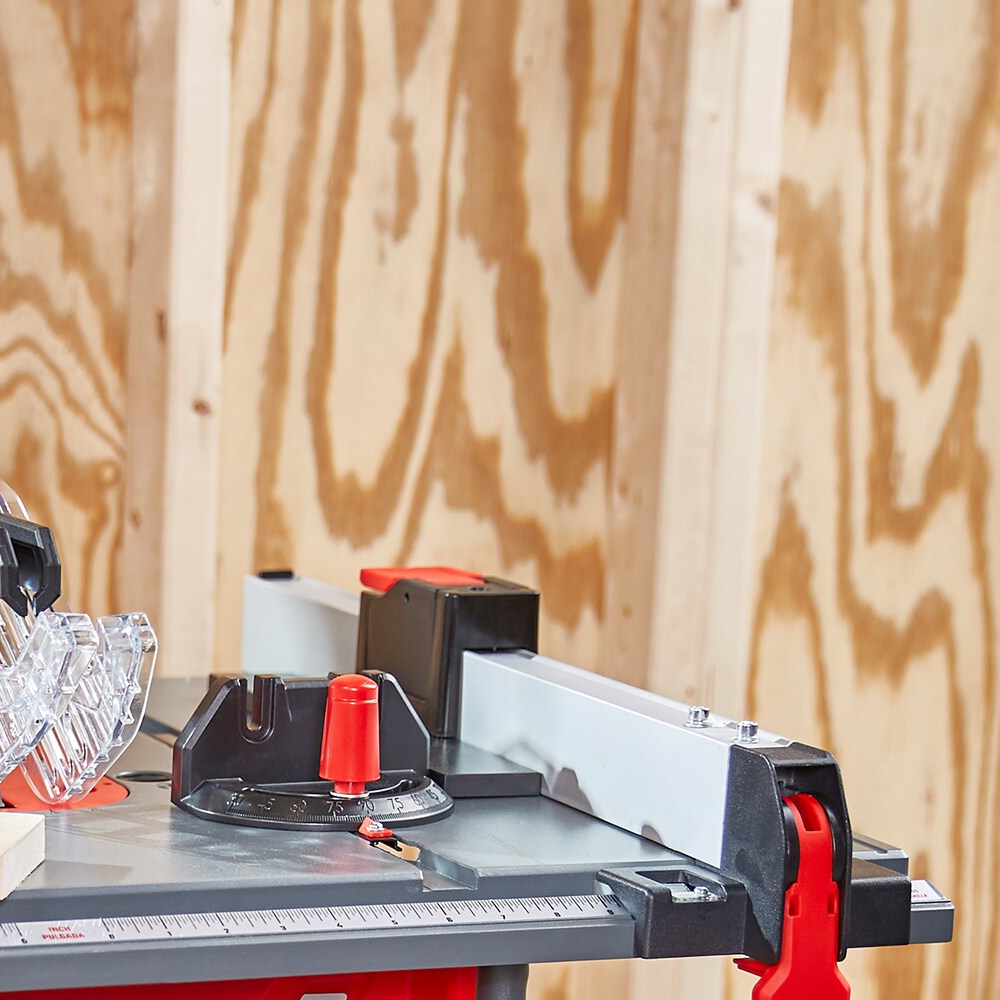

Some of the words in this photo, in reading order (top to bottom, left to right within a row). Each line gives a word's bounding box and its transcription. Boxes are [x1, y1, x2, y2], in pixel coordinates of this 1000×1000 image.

[326, 801, 344, 813] 75
[387, 797, 405, 810] 75
[48, 925, 71, 933] INCH
